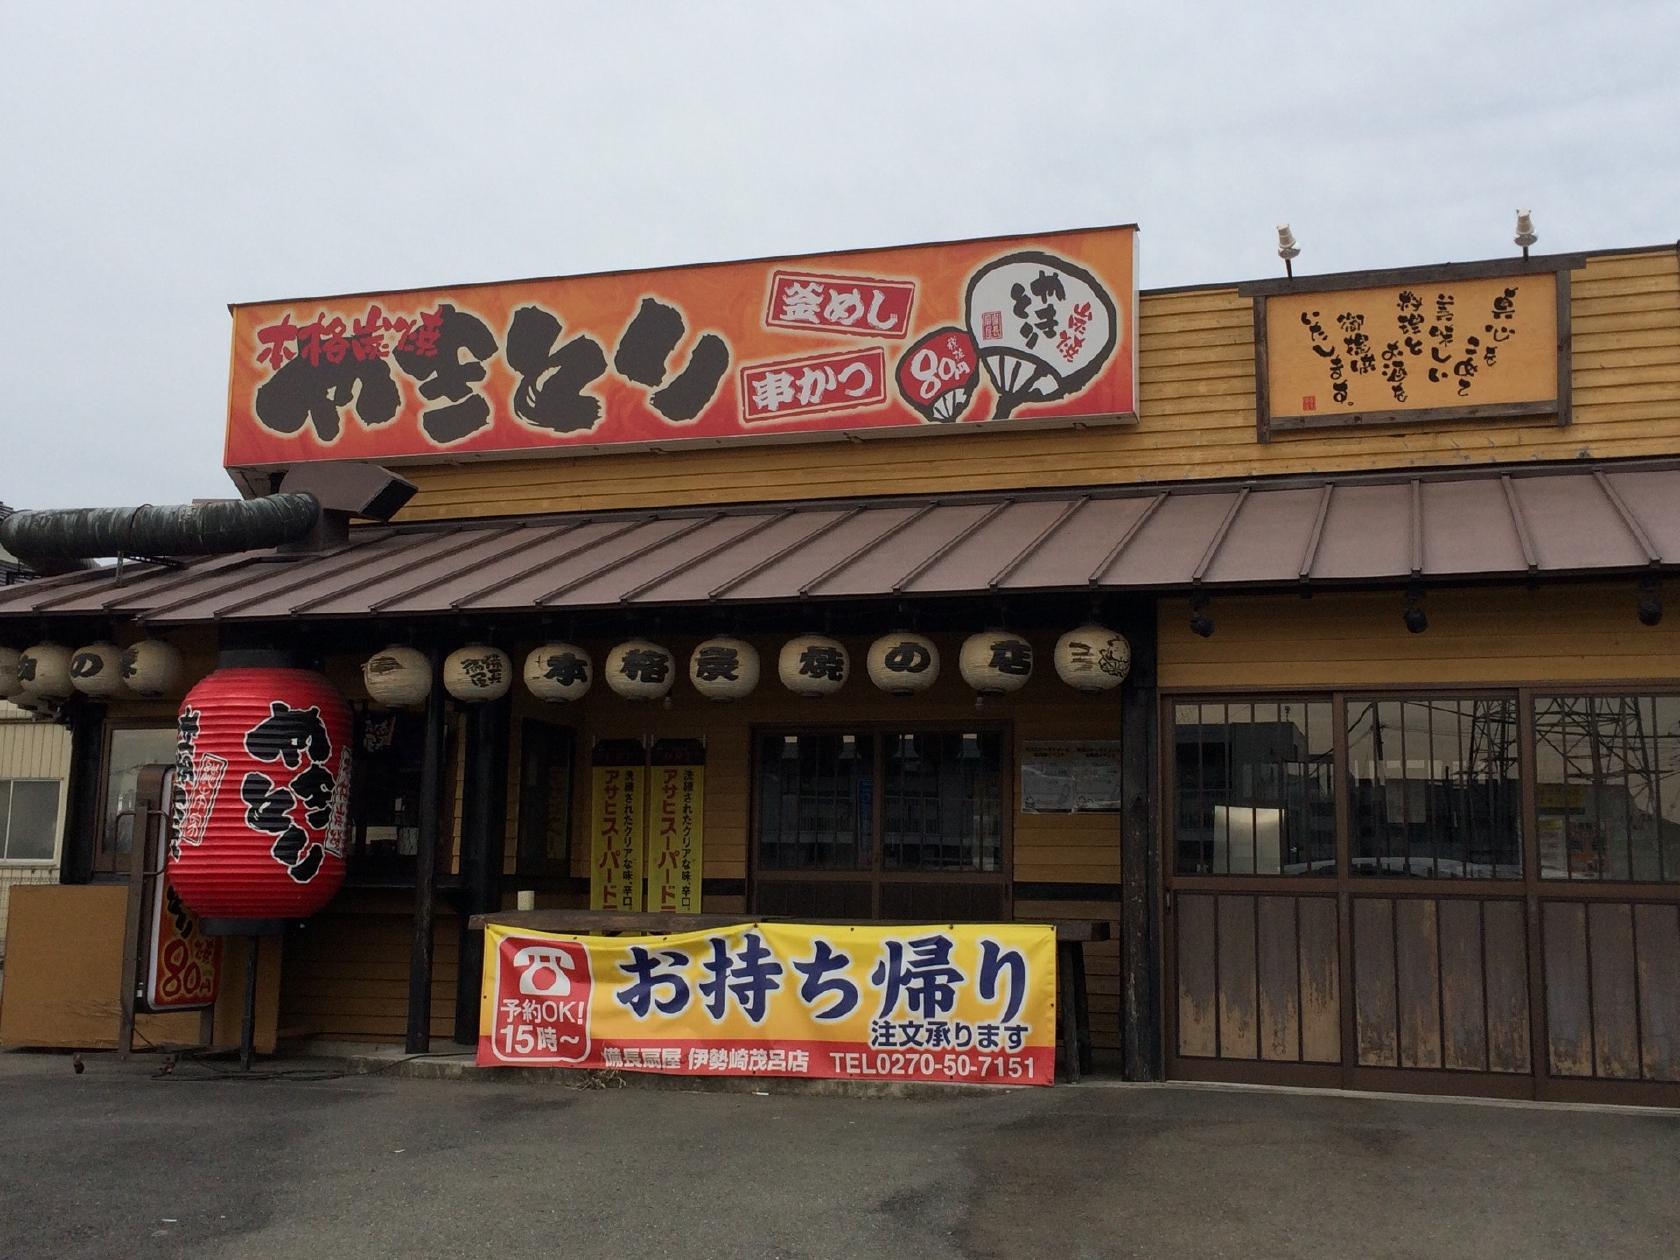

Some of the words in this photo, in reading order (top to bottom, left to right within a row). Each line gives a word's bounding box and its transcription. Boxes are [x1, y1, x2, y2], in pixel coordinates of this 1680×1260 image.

[780, 282, 898, 329] 釜めし
[1396, 290, 1425, 356] 料理と
[1485, 286, 1519, 367] 真心を
[1428, 293, 1455, 383] 美味しい
[1454, 336, 1481, 397] こめて
[256, 297, 730, 442] やきとり
[752, 361, 873, 412] 串かつ
[911, 349, 971, 399] 80円
[1381, 340, 1409, 403] お酒を
[71, 653, 104, 678] の
[241, 700, 336, 884] やきとり
[599, 770, 621, 910] アサヒスーパード
[657, 770, 680, 913] アサヒスーパード
[617, 934, 1028, 1024] お持ち帰り
[500, 999, 584, 1025] 予約OK!
[871, 1020, 1029, 1050] 注文承ります
[602, 1047, 681, 1070] 備長扇屋
[688, 1047, 810, 1073] 伊勢崎茂呂店
[829, 1052, 1035, 1079] TEL0270-50-7151
